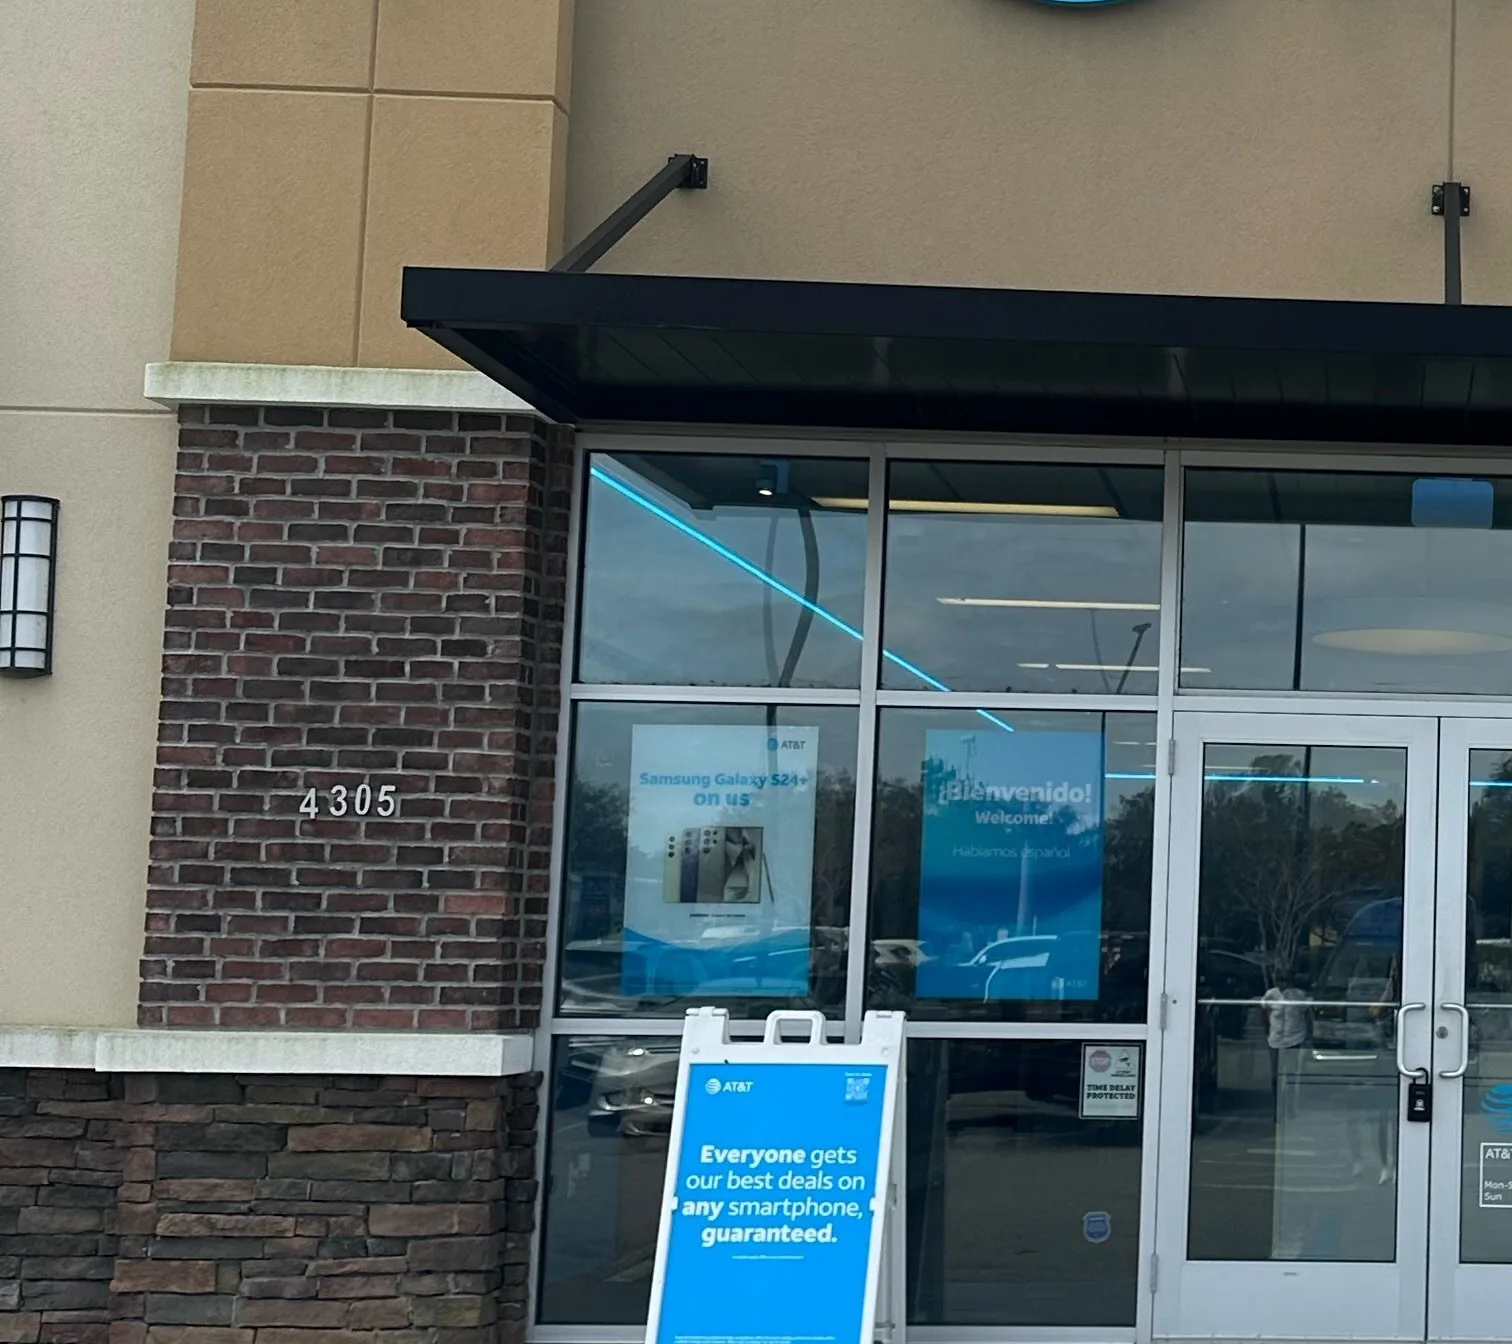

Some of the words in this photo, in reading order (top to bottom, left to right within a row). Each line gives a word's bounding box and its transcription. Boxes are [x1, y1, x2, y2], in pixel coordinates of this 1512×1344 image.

[780, 740, 806, 750] AT&T
[639, 772, 711, 789] Samsung
[714, 772, 767, 789] Galaxy
[770, 772, 808, 786] S24+
[693, 792, 720, 807] on
[938, 780, 1092, 804] ¡Bienvenido!
[299, 783, 396, 819] 4305
[975, 809, 1053, 825] Welcome!
[953, 844, 1018, 857] Hablamos
[1021, 846, 1070, 860] español
[722, 1081, 754, 1093] AT&T
[1109, 1084, 1136, 1092] DELAY
[1086, 1092, 1136, 1100] PROTECTED
[701, 1145, 806, 1168] Everyone
[811, 1146, 857, 1168] gets
[686, 1174, 723, 1190] our
[727, 1170, 774, 1190] best
[778, 1170, 833, 1190] deals
[838, 1174, 865, 1190] on
[1484, 1192, 1502, 1201] Sun
[682, 1200, 724, 1221] any
[728, 1196, 863, 1221] smartphone,
[701, 1223, 838, 1247] guaranteed.
